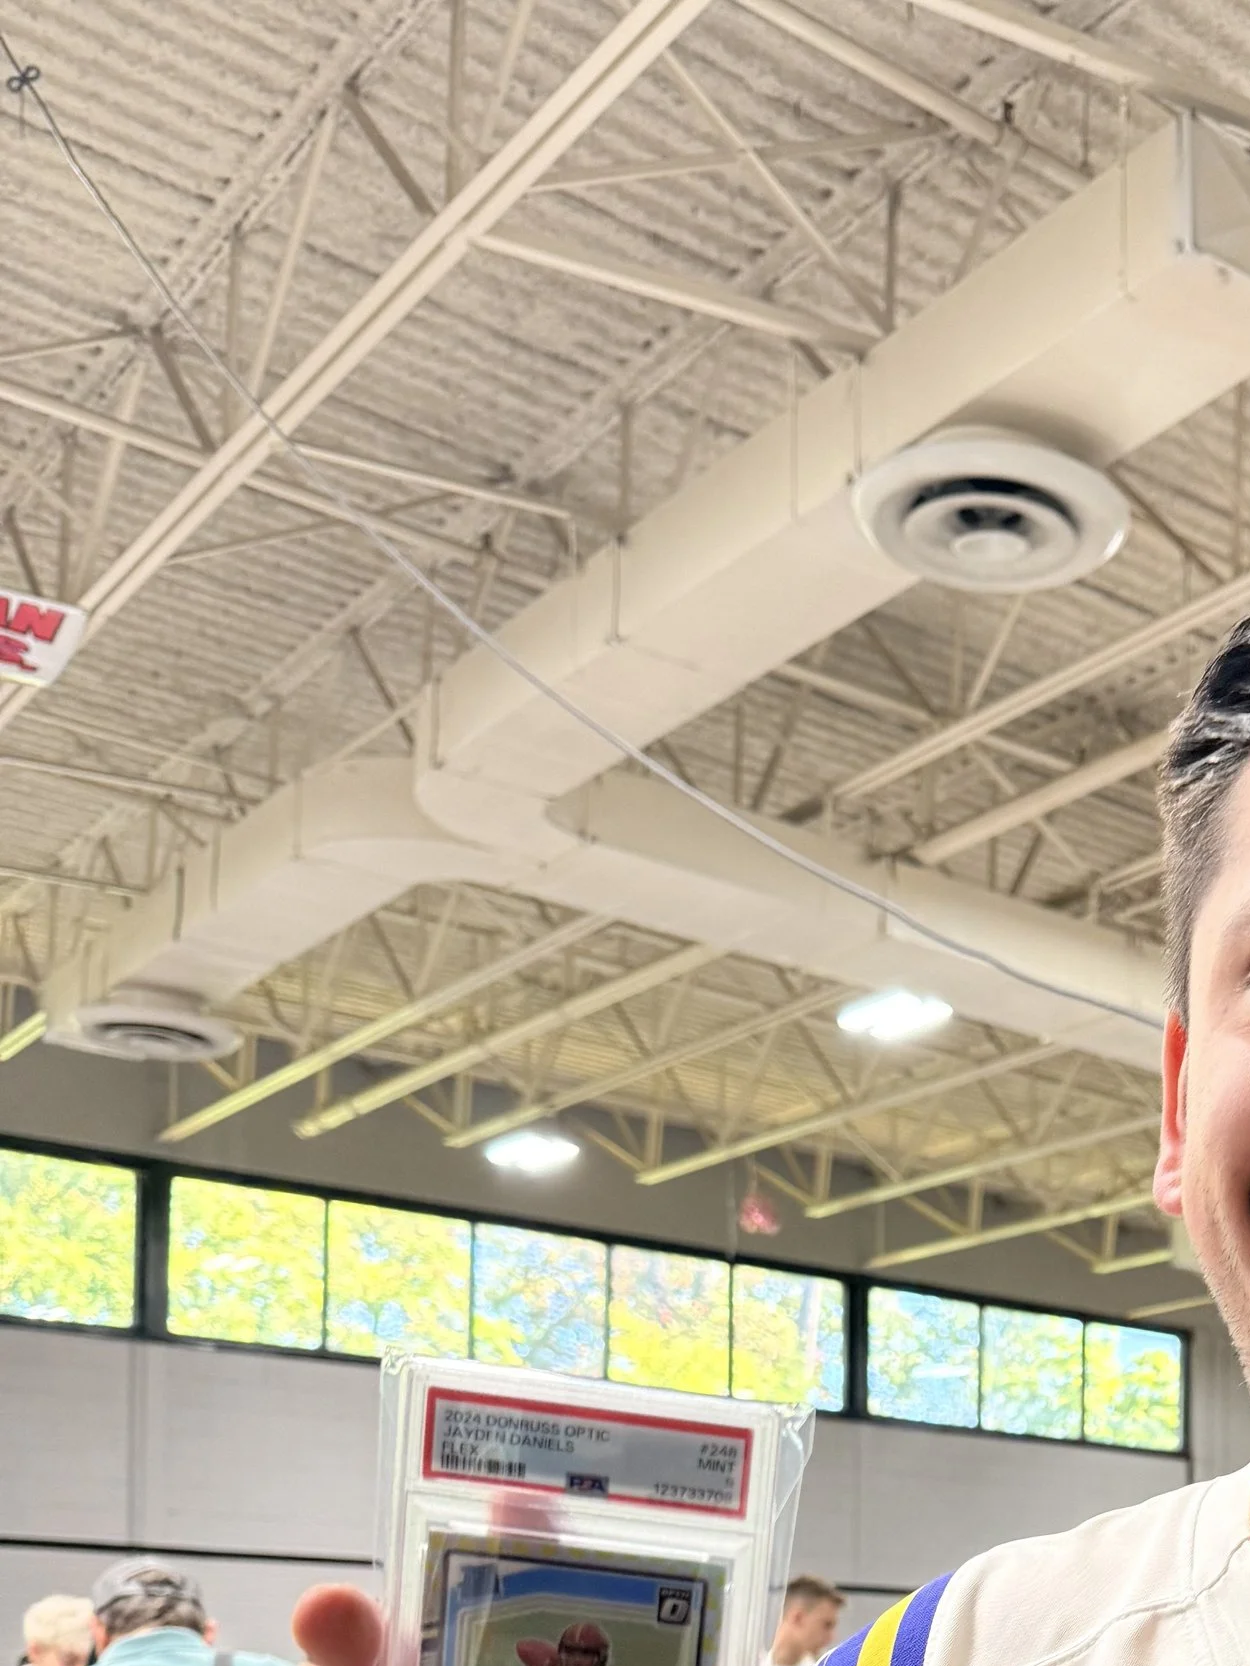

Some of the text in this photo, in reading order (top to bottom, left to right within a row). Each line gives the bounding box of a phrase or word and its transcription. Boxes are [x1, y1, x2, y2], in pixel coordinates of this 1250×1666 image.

[444, 1408, 611, 1443] 2024 DONRUSS OPTIC
[441, 1440, 480, 1456] FLEX
[443, 1425, 576, 1453] JAYDEN DANIELS
[698, 1458, 737, 1474] MINT
